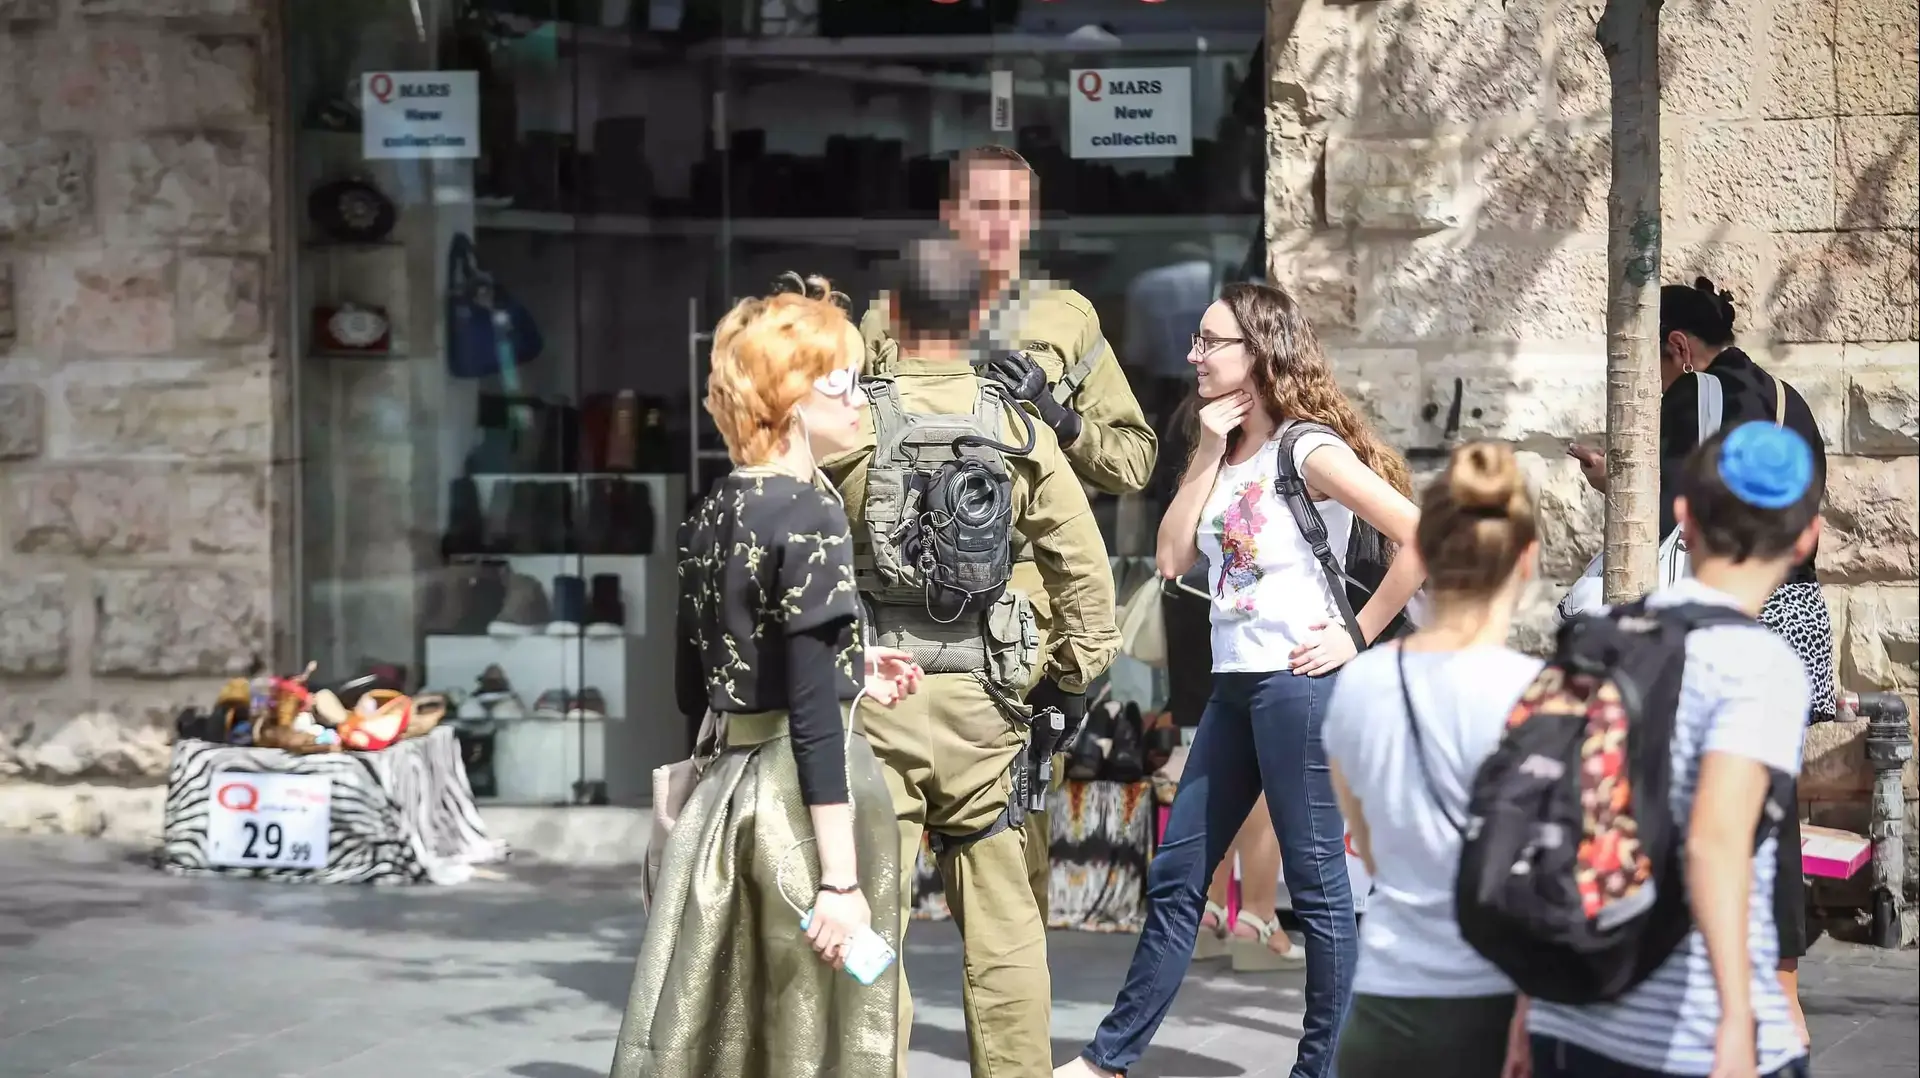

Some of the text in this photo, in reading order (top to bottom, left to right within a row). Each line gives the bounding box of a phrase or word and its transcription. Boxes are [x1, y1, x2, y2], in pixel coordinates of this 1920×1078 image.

[369, 73, 451, 104] Q MARS
[1078, 71, 1163, 101] Q MARS
[1115, 106, 1153, 119] New
[1091, 131, 1178, 147] collection
[217, 782, 259, 814] Q
